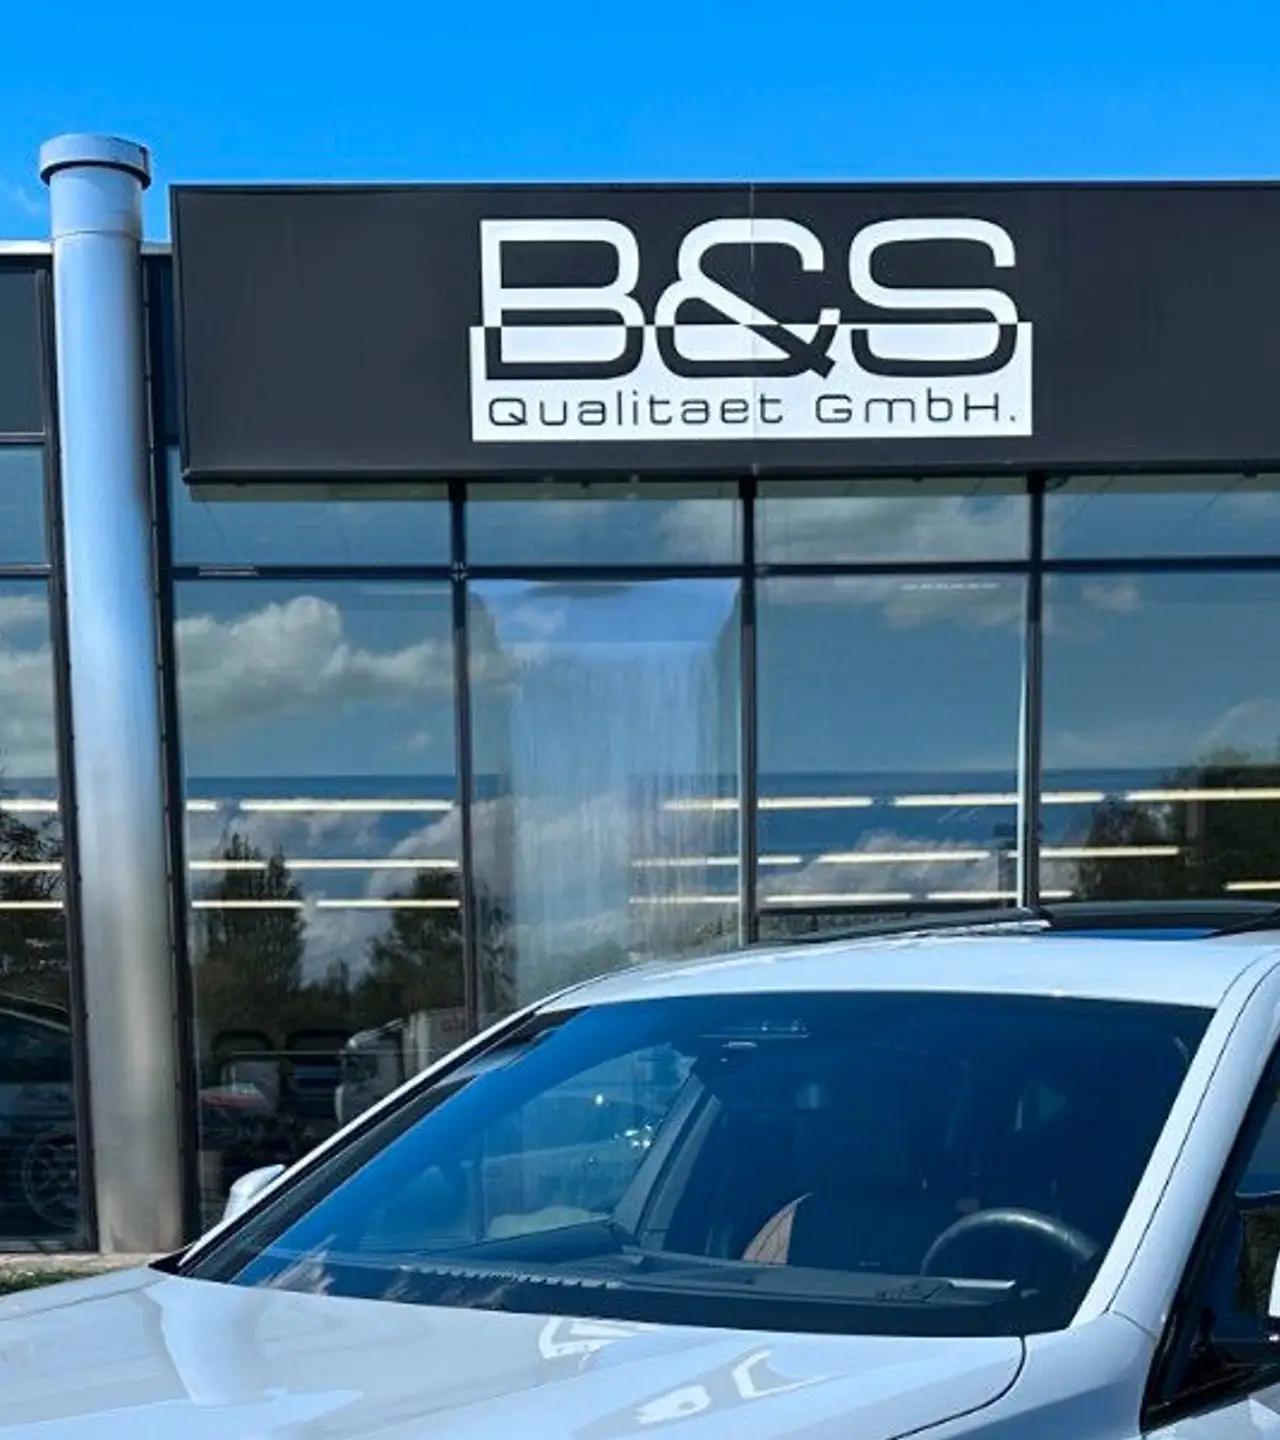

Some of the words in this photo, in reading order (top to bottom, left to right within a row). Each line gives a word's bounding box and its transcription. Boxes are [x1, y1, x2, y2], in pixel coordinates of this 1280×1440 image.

[480, 217, 1020, 381] B&S
[487, 390, 784, 428] Qualitaet
[815, 387, 1018, 424] GmbH.
